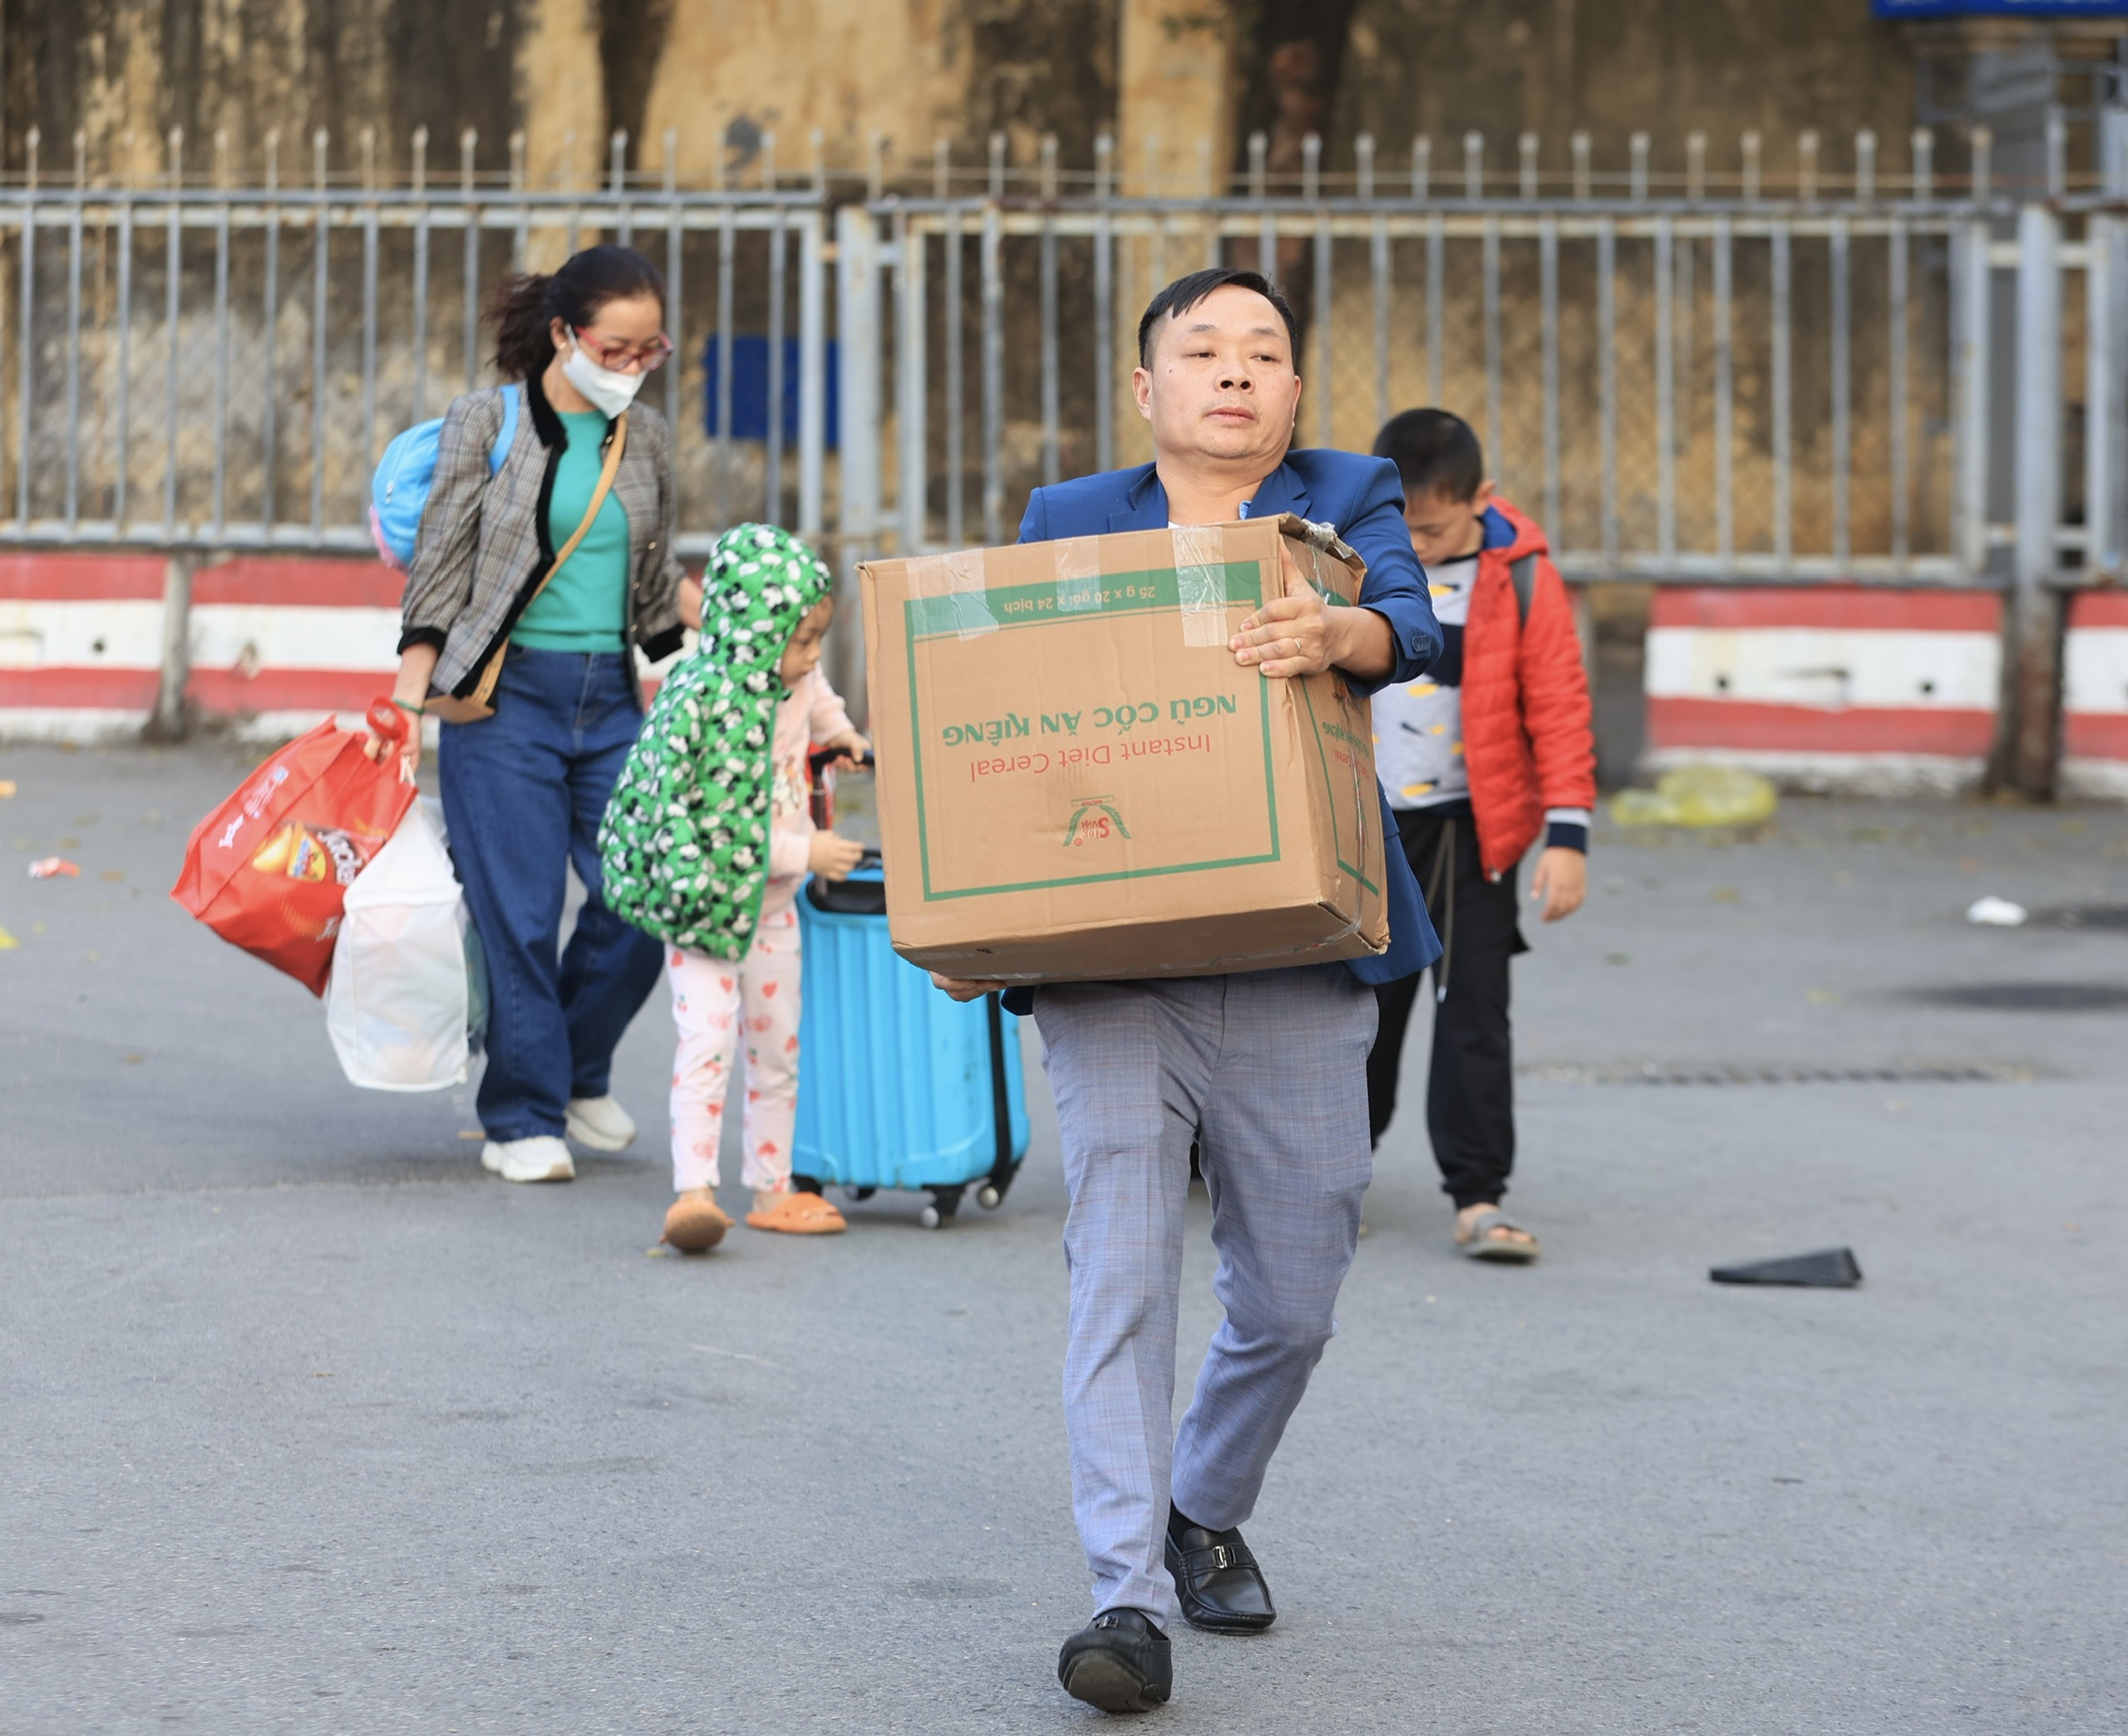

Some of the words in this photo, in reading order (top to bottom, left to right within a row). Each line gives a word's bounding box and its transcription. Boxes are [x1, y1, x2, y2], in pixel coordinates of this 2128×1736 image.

[1057, 595, 1065, 606] x
[1094, 590, 1111, 602] 20
[1114, 589, 1123, 598] x
[1126, 585, 1135, 598] g
[1139, 586, 1155, 599] 25
[1003, 598, 1033, 614] bịch
[1037, 598, 1053, 610] 24
[1092, 701, 1160, 735] CỐC
[1170, 694, 1237, 725] NGŨ
[942, 712, 1030, 747] KIÊNG
[1040, 711, 1082, 736] ĂN
[1057, 745, 1111, 768] Diet
[1120, 734, 1211, 760] Instant
[970, 753, 1050, 783] Cereal
